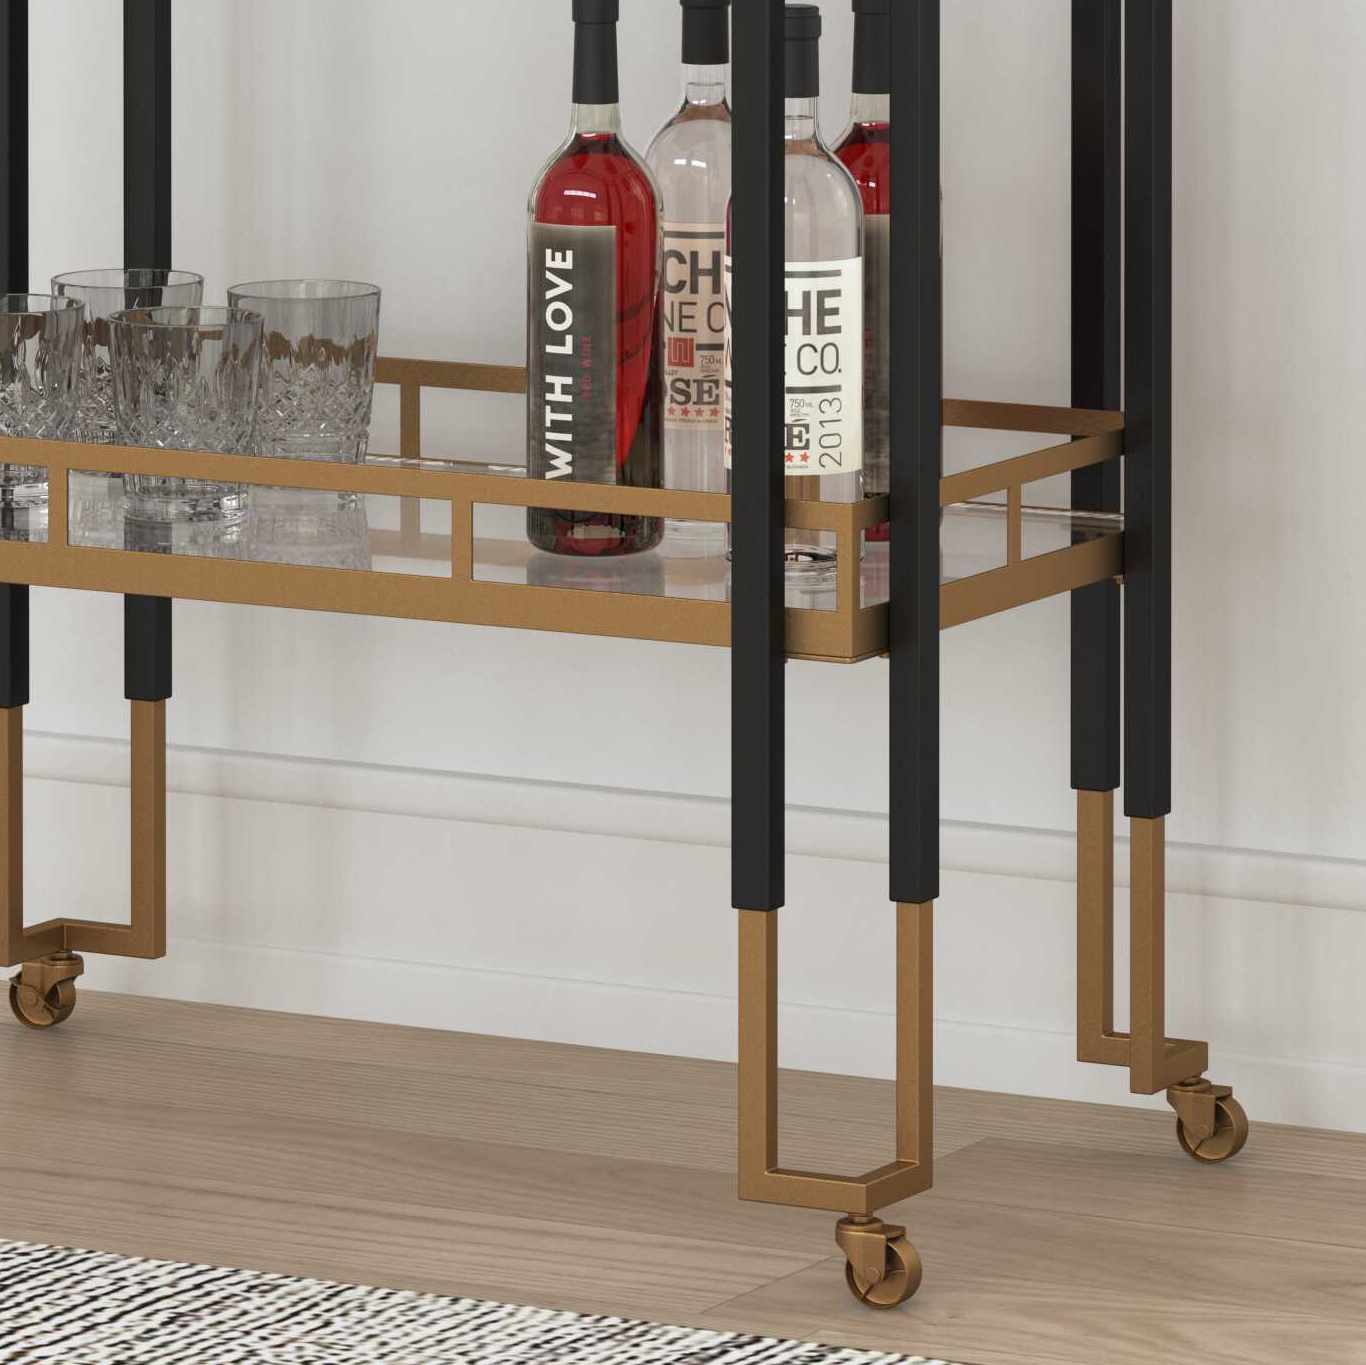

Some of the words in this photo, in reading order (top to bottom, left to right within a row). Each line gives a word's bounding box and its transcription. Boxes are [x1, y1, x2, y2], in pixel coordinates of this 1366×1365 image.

[664, 249, 722, 295] CH
[545, 248, 573, 354] LOVE
[663, 301, 698, 333] NE
[784, 289, 842, 336] HE
[796, 342, 842, 376] CO.
[669, 374, 720, 406] SÉ
[545, 374, 573, 480] WITH
[818, 397, 842, 469] 2013
